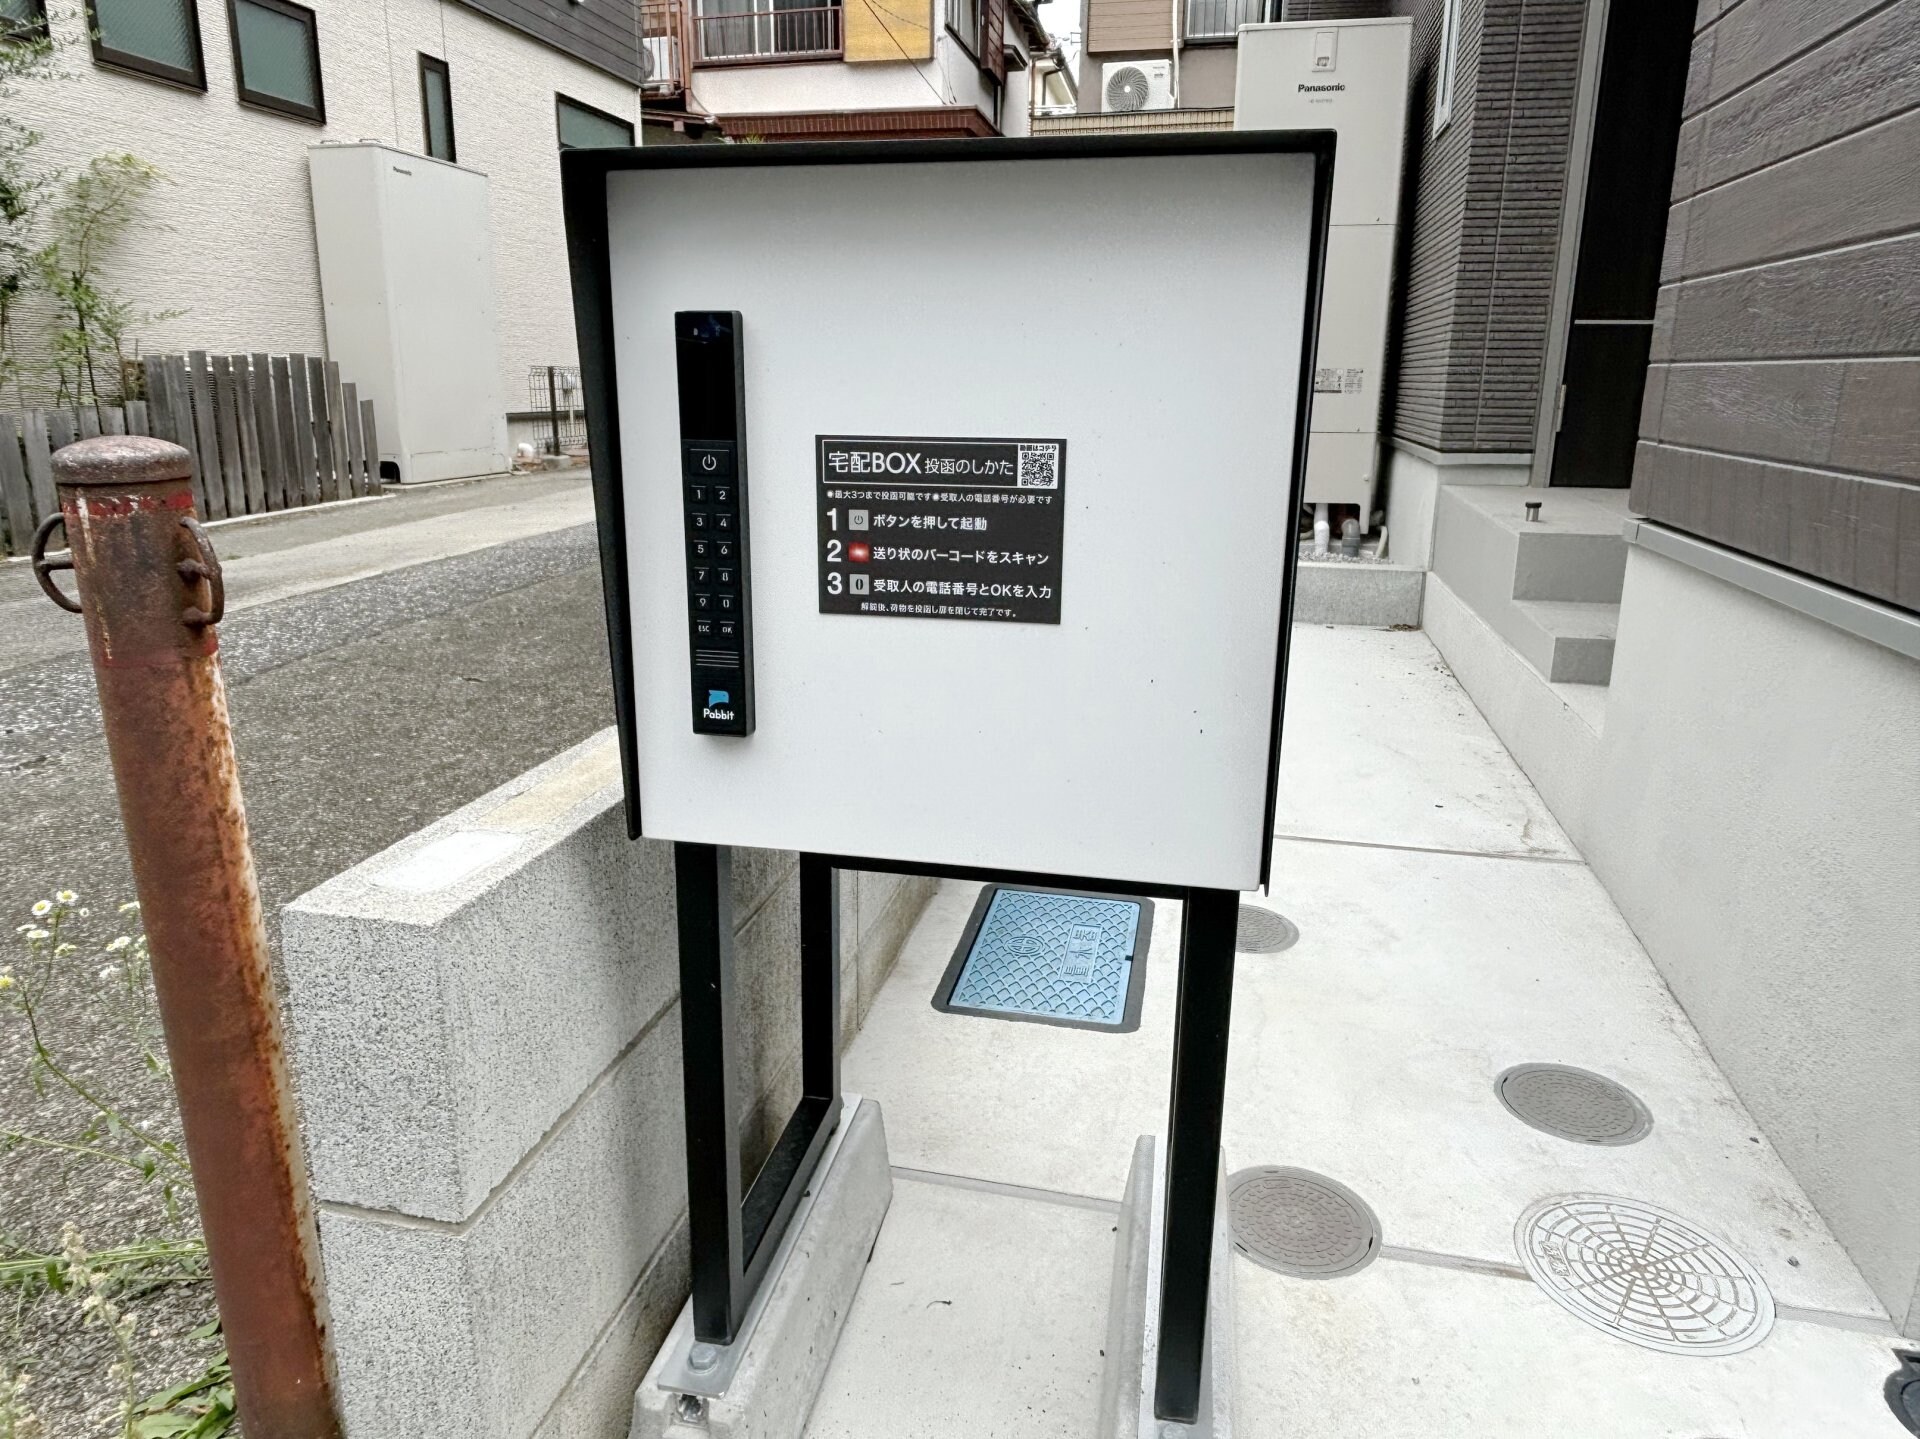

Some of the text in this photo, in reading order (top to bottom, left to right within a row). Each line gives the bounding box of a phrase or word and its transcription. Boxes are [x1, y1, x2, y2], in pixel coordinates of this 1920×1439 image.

[1298, 83, 1346, 93] Panasonic
[1019, 444, 1057, 453] はコチラ
[828, 450, 1014, 475] 宅配BOX 投函のしかた
[697, 489, 726, 500] 1 2
[696, 517, 727, 527] 3 4
[826, 507, 987, 531] 1 ボタンを押して起動
[697, 544, 728, 555] 5 6
[826, 539, 1049, 566] 2 送り状のバーコードをスキャン
[698, 570, 729, 582] 7 8
[827, 571, 843, 595] 3
[873, 579, 1052, 599] 受取人の電話番号とOKを入力
[699, 597, 730, 608] 9 0
[722, 626, 732, 634] OK
[703, 708, 734, 720] Pabbit
